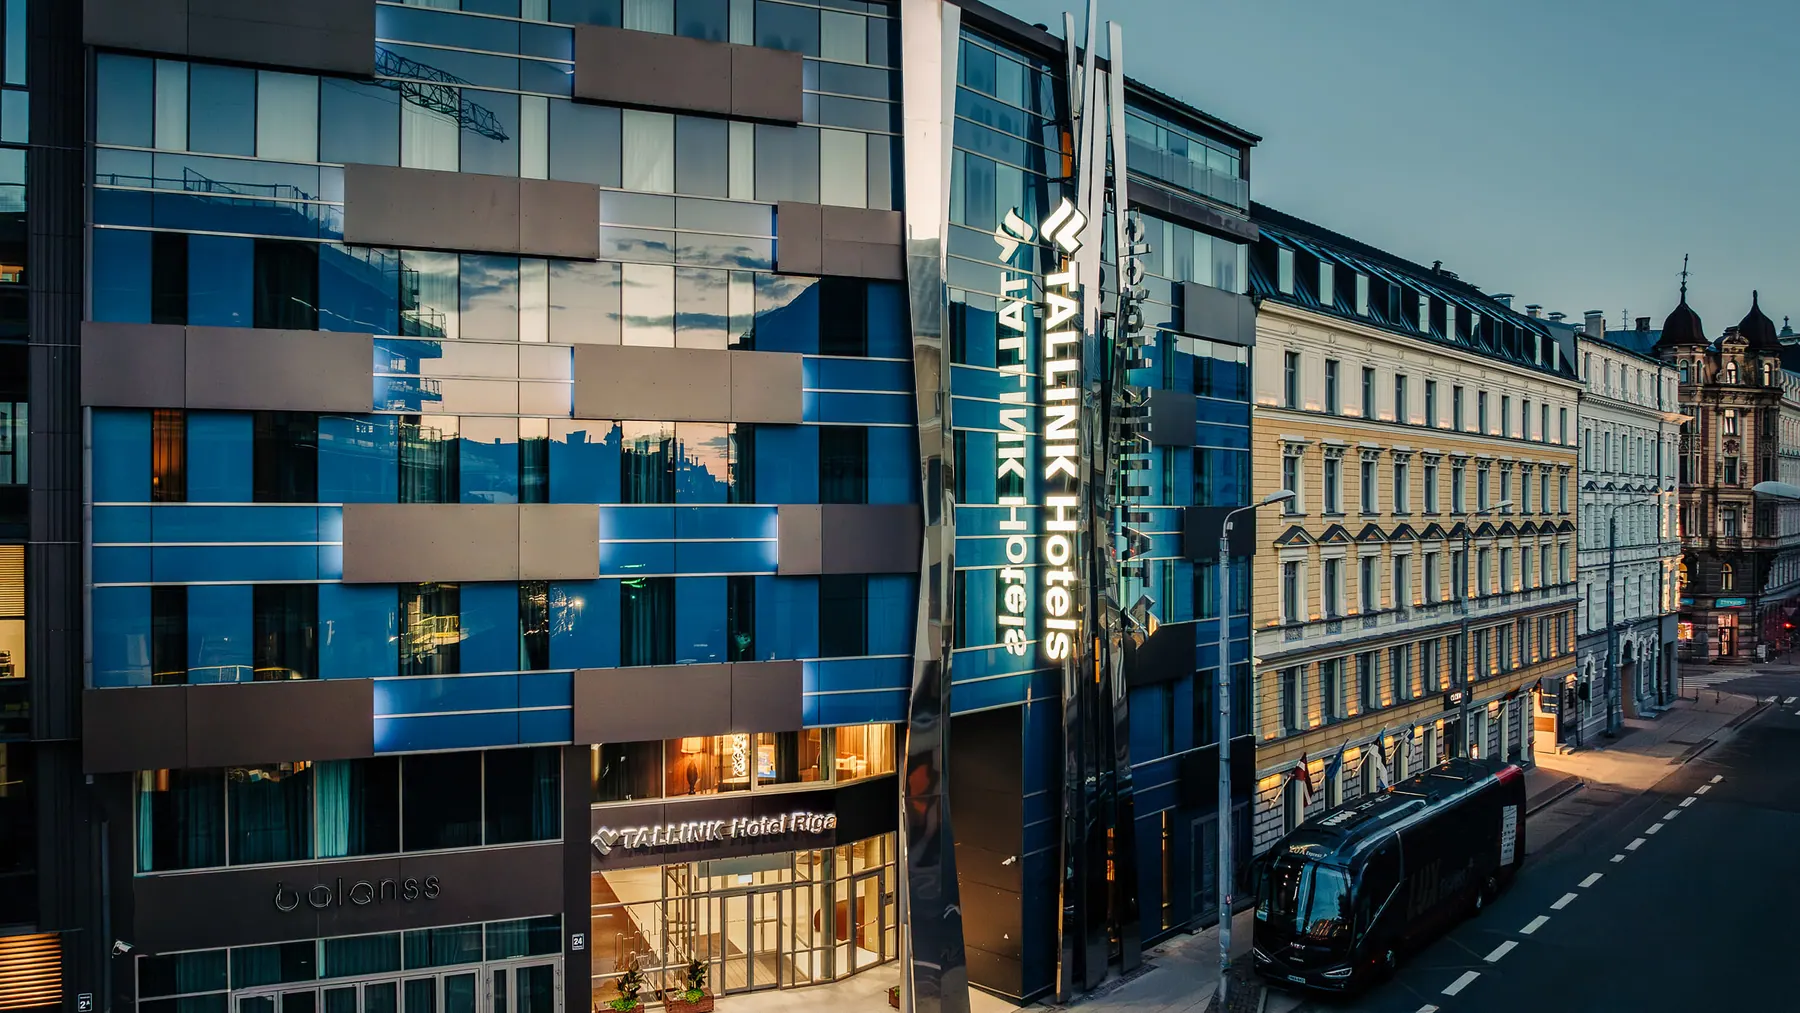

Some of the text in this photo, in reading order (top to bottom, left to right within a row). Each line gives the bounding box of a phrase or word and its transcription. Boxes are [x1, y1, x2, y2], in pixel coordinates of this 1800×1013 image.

[1044, 260, 1080, 662] TALLINK Hotels
[620, 811, 837, 849] TALLINK Hotel Riga
[573, 937, 583, 946] 24
